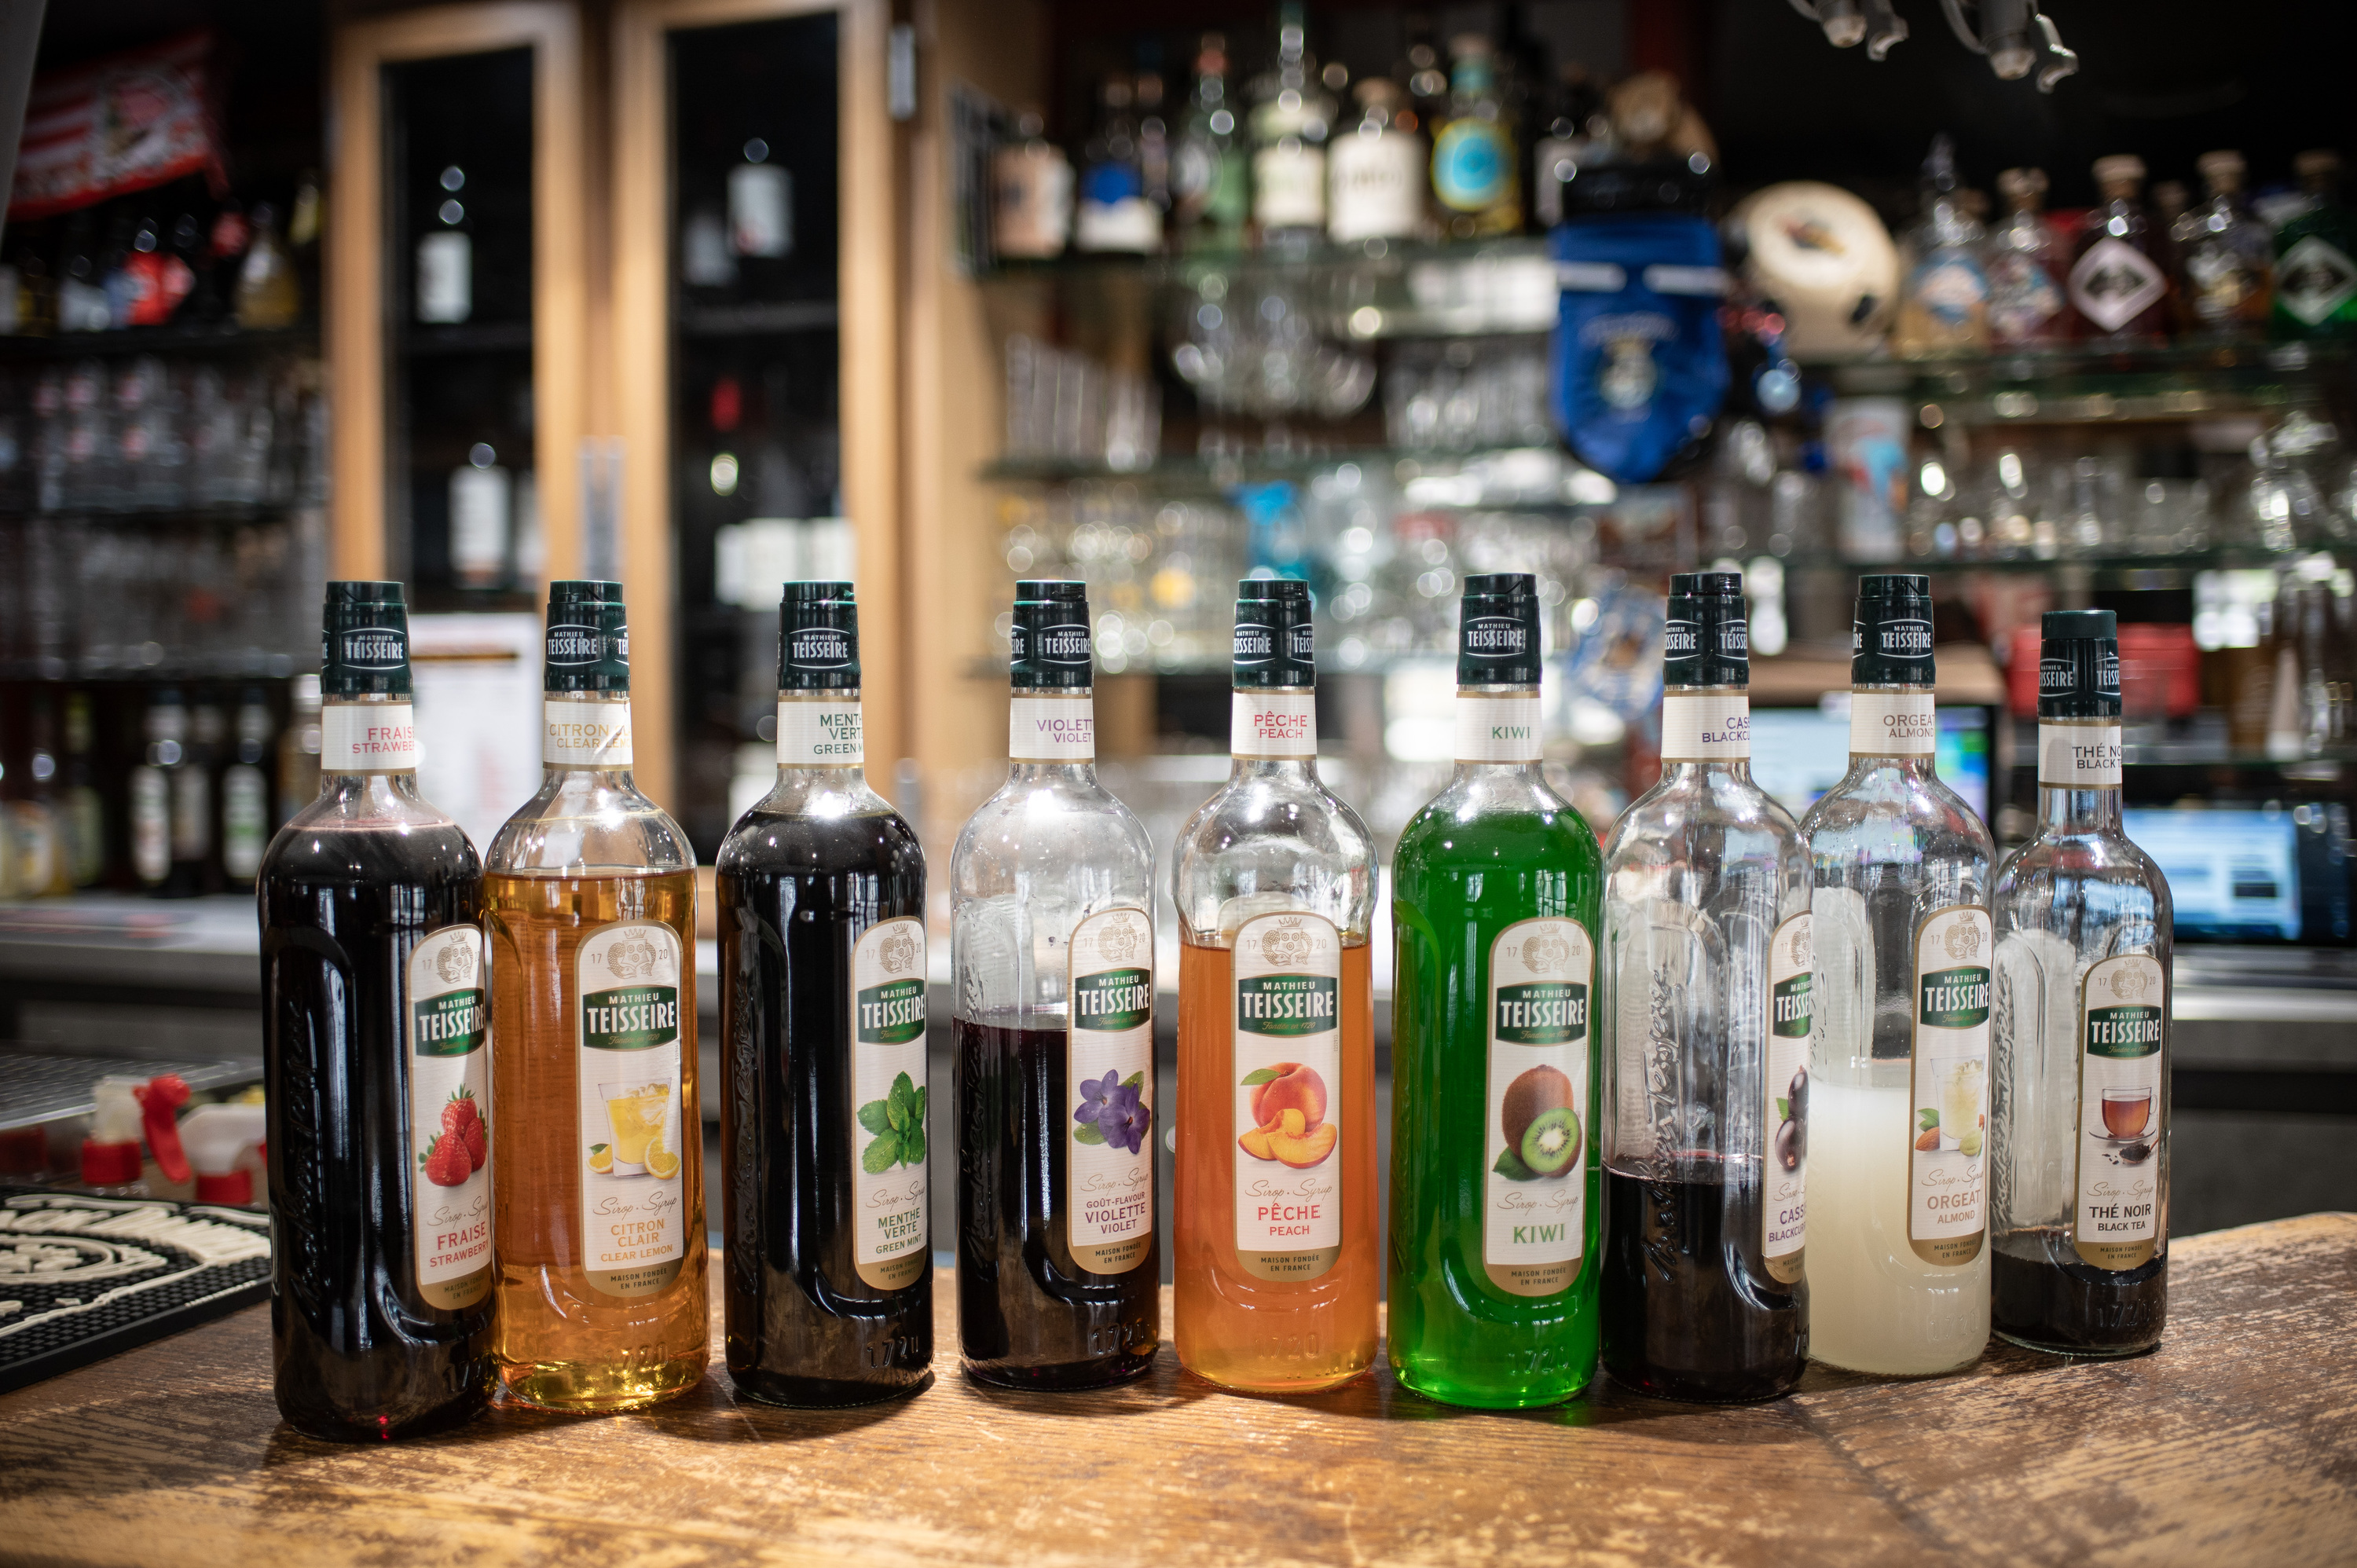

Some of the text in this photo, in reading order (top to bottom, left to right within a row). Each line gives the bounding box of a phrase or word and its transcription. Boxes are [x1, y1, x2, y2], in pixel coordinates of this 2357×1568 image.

[1045, 637, 1091, 654] TEISSEIRE
[1234, 637, 1271, 654] EISSEIRE
[1468, 630, 1523, 647] TEISSEIRE
[1720, 633, 1747, 650] TEISSE
[1881, 632, 1931, 648] TEISSEIRE
[346, 642, 404, 659] TEISSEIRE
[548, 638, 597, 655] TEISSEIRE
[793, 642, 848, 658] TEISSEIRE
[820, 713, 862, 727] MENT
[1036, 720, 1093, 731] VIOLETT
[1254, 711, 1307, 727] PÊCHE
[1726, 717, 1750, 730] CASS
[549, 724, 610, 737] CITRON
[829, 727, 863, 740] VERT
[1054, 733, 1091, 742] VIOLET
[1259, 728, 1303, 738] PEACH
[1492, 726, 1530, 739] KIWI
[1702, 731, 1750, 742] BLACKCU
[1889, 728, 1934, 738] ALMOND
[353, 742, 415, 754] STRAWBE
[557, 738, 600, 749] CLEAR
[814, 743, 856, 754] GREEN
[2072, 742, 2105, 758] THÉ
[2077, 759, 2116, 768] BLACK
[1083, 932, 1145, 947] 17 20
[1247, 939, 1327, 950] 17 20
[1930, 932, 1988, 944] 17 20
[866, 950, 875, 960] 17
[1507, 946, 1580, 957] 17 20
[1780, 943, 1788, 953] 17
[592, 948, 669, 964] 17 20
[422, 959, 432, 970] 17
[1098, 975, 1139, 987] MATHIEU
[1263, 981, 1315, 991] MATHIEU
[1945, 973, 1981, 984] MATHIEU
[2150, 976, 2156, 985] 20
[608, 992, 660, 1005] MATHIEU
[881, 985, 917, 999] MATHIEU
[1523, 989, 1571, 998] MATHIEU
[1925, 983, 1989, 1012] TEISSEIRE
[438, 995, 476, 1010] MATHIEU
[1079, 984, 1149, 1016] TEISSEIRE
[1242, 991, 1333, 1018] TEISSEIRE
[1776, 992, 1810, 1021] TEISSE
[587, 1001, 675, 1034] TEISSEIRE
[862, 994, 925, 1029] TEISSEIRE
[1501, 998, 1584, 1028] TEISSEIRE
[2110, 1011, 2150, 1020] MATHIEU
[419, 1004, 484, 1042] TEISSEIRE
[2091, 1020, 2160, 1043] TEISSEIRE
[1080, 1174, 1116, 1196] Sirop
[1921, 1169, 1956, 1192] Sirop
[1244, 1178, 1332, 1203] Sirop Syrup
[1773, 1182, 1798, 1204] Sirop
[2087, 1180, 2153, 1202] Sirop Syrup
[592, 1191, 677, 1221] Sirop Syrup
[866, 1189, 900, 1212] Sirop
[1086, 1191, 1146, 1209] GOÛT-FLAVOUR
[1497, 1189, 1578, 1216] Sirop Syrup
[1927, 1189, 1981, 1210] ORGEAT
[427, 1206, 462, 1229] Sirop
[878, 1207, 920, 1229] MENTHE
[1085, 1202, 1146, 1223] VIOLETTE
[1257, 1203, 1321, 1221] PÊCHE
[1937, 1210, 1975, 1224] ALMOND
[2089, 1203, 2151, 1218] THÉ NOIR
[610, 1218, 666, 1236] CITRON
[885, 1221, 917, 1240] VERTE
[1101, 1218, 1138, 1234] VIOLET
[1270, 1225, 1310, 1236] PEACH
[2098, 1221, 2146, 1231] BLACK TEA
[437, 1221, 486, 1251] FRAISE
[618, 1232, 659, 1247] CLAIR
[1513, 1224, 1565, 1244] KIWI
[875, 1233, 922, 1254] GREEN MINT
[430, 1238, 489, 1268] STRAWBERRY
[600, 1244, 673, 1262] CLEAR LEMON
[1095, 1247, 1120, 1257] MAISON
[1115, 1251, 1135, 1262] FRANCE
[1294, 1254, 1320, 1262] FONDÉE
[1952, 1248, 1971, 1257] FRANCE
[610, 1266, 668, 1282] MAISON FONDÉE
[880, 1264, 903, 1273] MAISON
[1543, 1266, 1566, 1276] FONDÉE
[445, 1281, 468, 1293] MAISON
[633, 1277, 660, 1288] FRANCE
